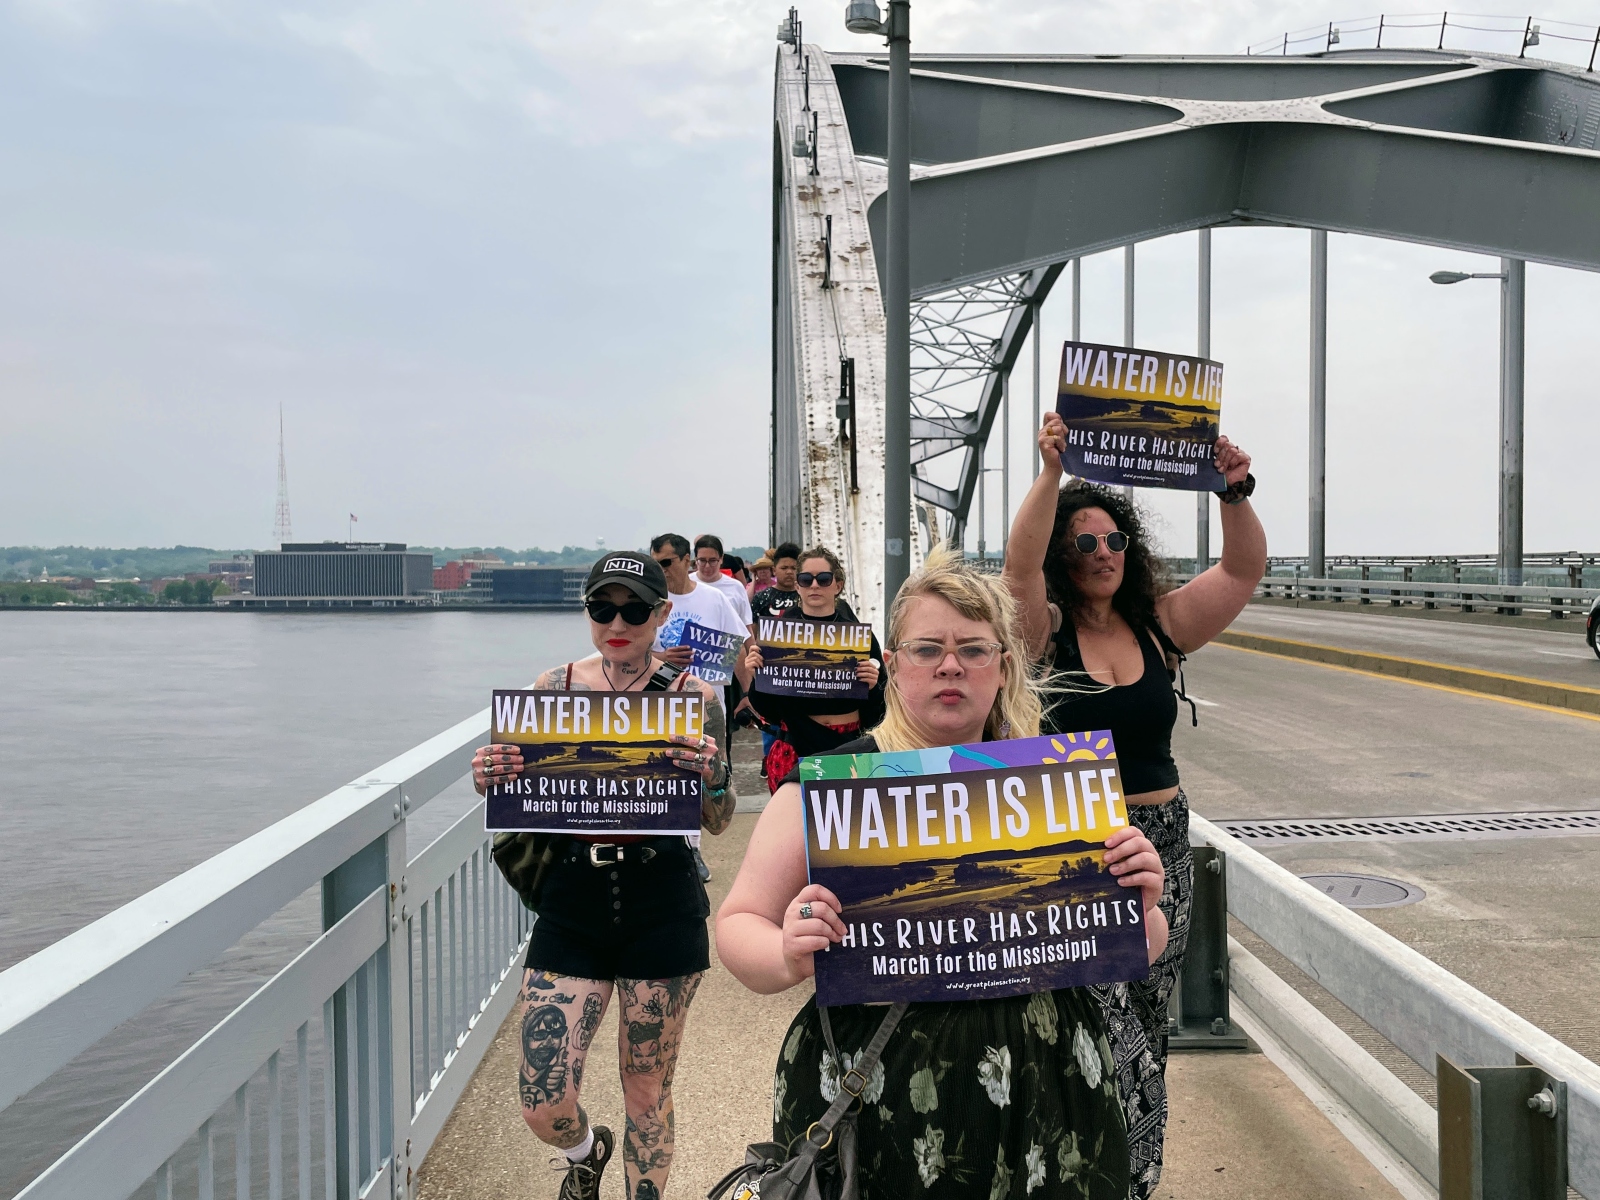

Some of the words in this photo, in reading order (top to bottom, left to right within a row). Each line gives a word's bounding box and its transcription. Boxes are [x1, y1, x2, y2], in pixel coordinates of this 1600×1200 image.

[1065, 346, 1159, 394] WATER
[1165, 359, 1190, 398] IS
[1191, 363, 1223, 404] LIFE
[1068, 429, 1095, 447] HIS
[1100, 431, 1147, 453] RIVER
[1152, 437, 1175, 456] HAS
[1177, 439, 1217, 460] RIGHT
[1083, 451, 1116, 467] March
[1119, 456, 1135, 469] for
[1137, 458, 1153, 471] the
[1153, 460, 1198, 476] Mississippi
[689, 626, 735, 650] WALK
[759, 618, 815, 646] WATER
[820, 624, 836, 647] IS
[840, 625, 871, 648] LIFE
[690, 647, 724, 665] FOR
[683, 664, 726, 682] IVER
[772, 677, 793, 687] March
[794, 680, 804, 688] for
[805, 681, 816, 689] the
[817, 682, 852, 691] Mississippi
[782, 666, 811, 679] RIVER
[814, 668, 833, 681] HAS
[494, 695, 592, 735] WATER
[602, 696, 631, 736] IS
[641, 697, 700, 736] LIFE
[539, 776, 590, 797] RIVER
[596, 777, 630, 798] HAS
[636, 777, 699, 797] RIGHTS
[522, 799, 558, 813] March
[561, 799, 578, 813] for
[580, 800, 600, 814] the
[602, 800, 669, 816] Mississippi
[808, 781, 972, 851] WATER
[985, 776, 1031, 841] IS
[1040, 767, 1126, 835] LIFE
[824, 922, 886, 952] HIS
[896, 916, 980, 950] RIVER
[988, 910, 1038, 943] HAS
[1047, 899, 1141, 936] RIGHTS
[872, 954, 931, 976] March
[935, 953, 963, 975] for
[967, 950, 998, 972] the
[1002, 935, 1098, 970] Mississippi
